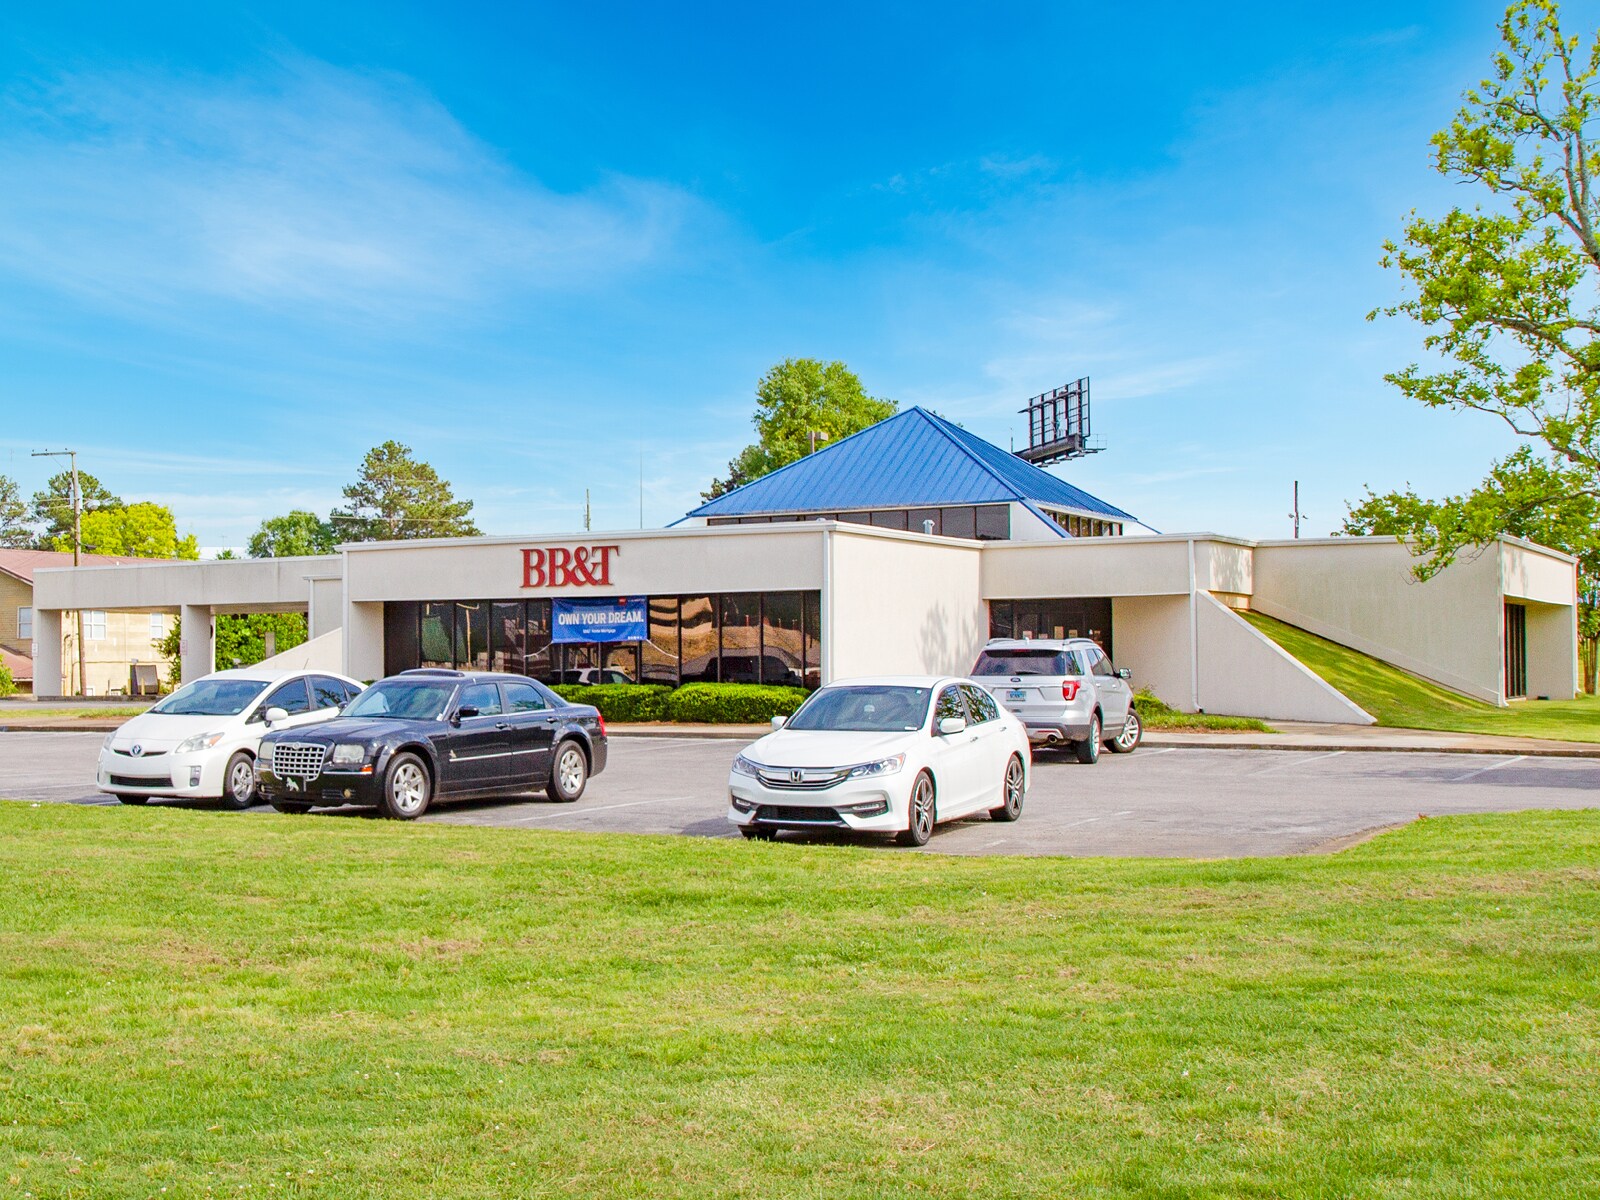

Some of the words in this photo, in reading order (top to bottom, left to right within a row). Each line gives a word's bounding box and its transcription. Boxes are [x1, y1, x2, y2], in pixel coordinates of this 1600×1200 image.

[519, 545, 620, 588] BB&T
[558, 613, 580, 625] OWN
[582, 612, 606, 625] YOUR
[608, 611, 645, 624] DREAM.
